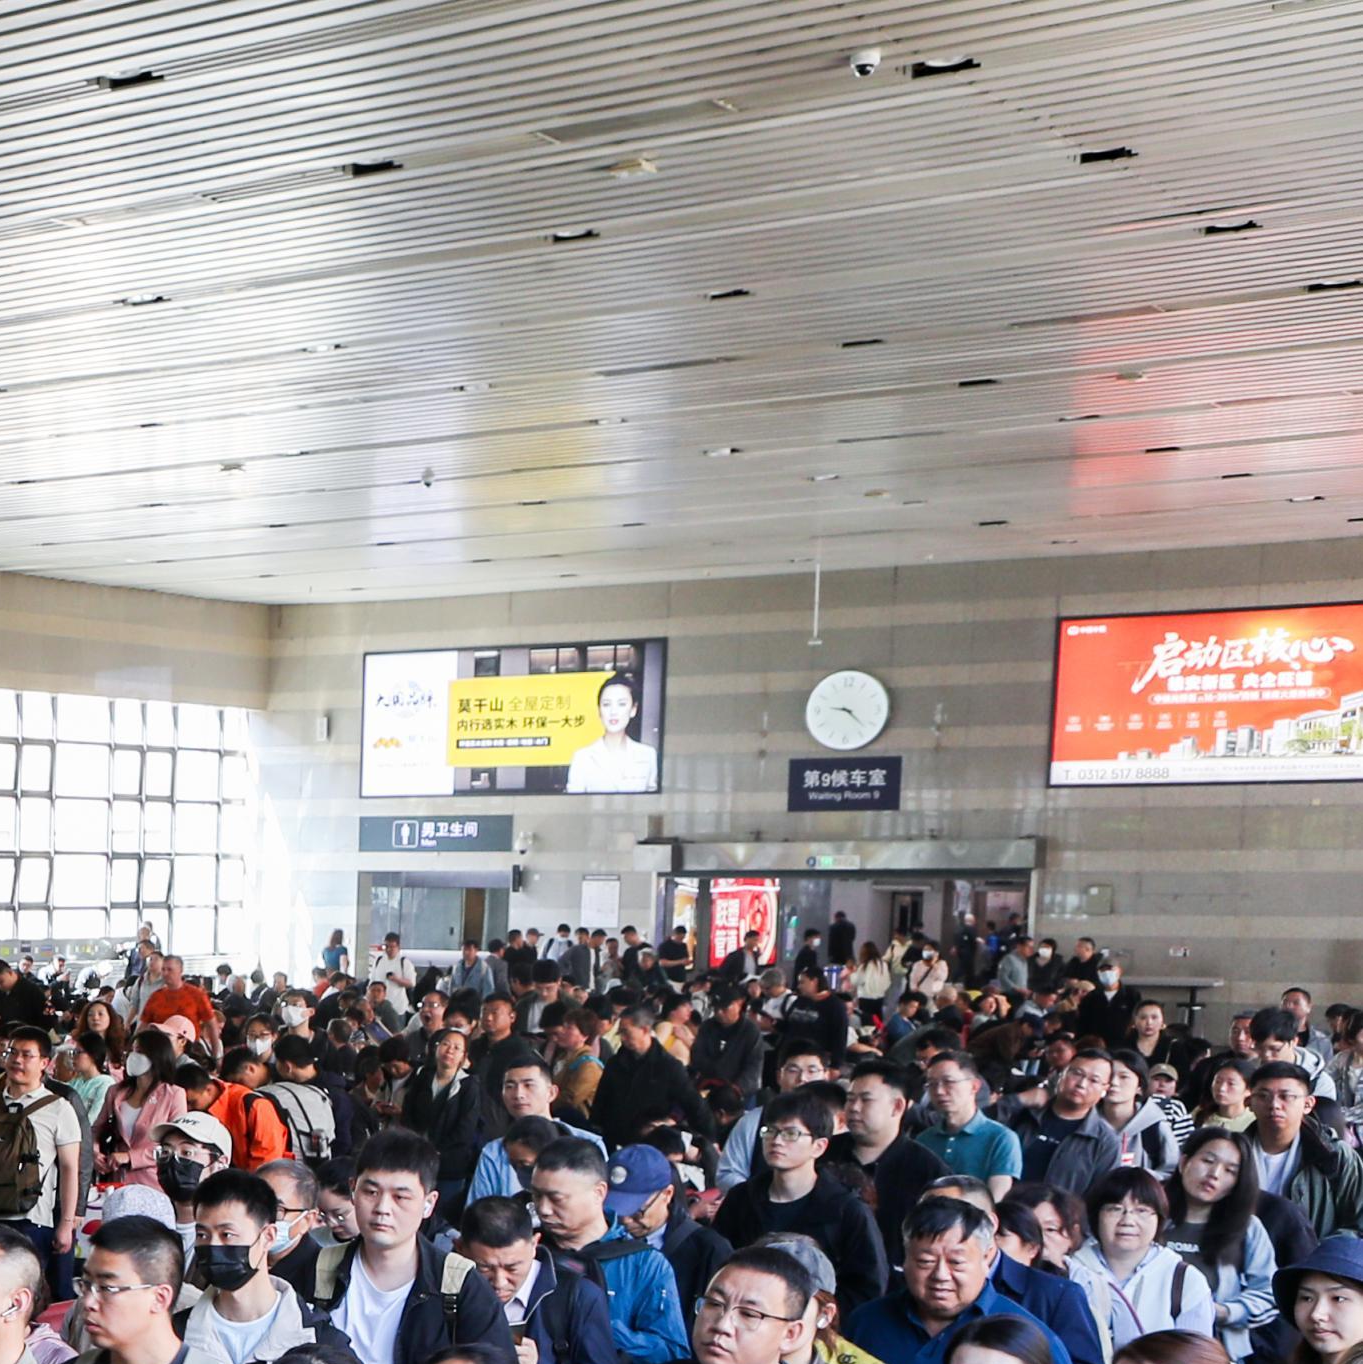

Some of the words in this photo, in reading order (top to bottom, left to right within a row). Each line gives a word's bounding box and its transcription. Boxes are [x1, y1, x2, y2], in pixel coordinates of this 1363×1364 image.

[1131, 628, 1355, 694] 启动区核心
[458, 697, 503, 713] 莫干山
[509, 695, 571, 711] 全屋定制
[457, 718, 517, 731] 内行选实木
[523, 715, 585, 729] 环保一大步
[803, 768, 887, 788] 第9候车室
[1078, 768, 1107, 780] 0312
[1112, 768, 1131, 780] 517
[1135, 767, 1170, 779] 8888
[809, 791, 842, 802] Waiting
[844, 790, 871, 800] Room
[873, 790, 880, 799] 9
[421, 821, 478, 838] 男卫生间
